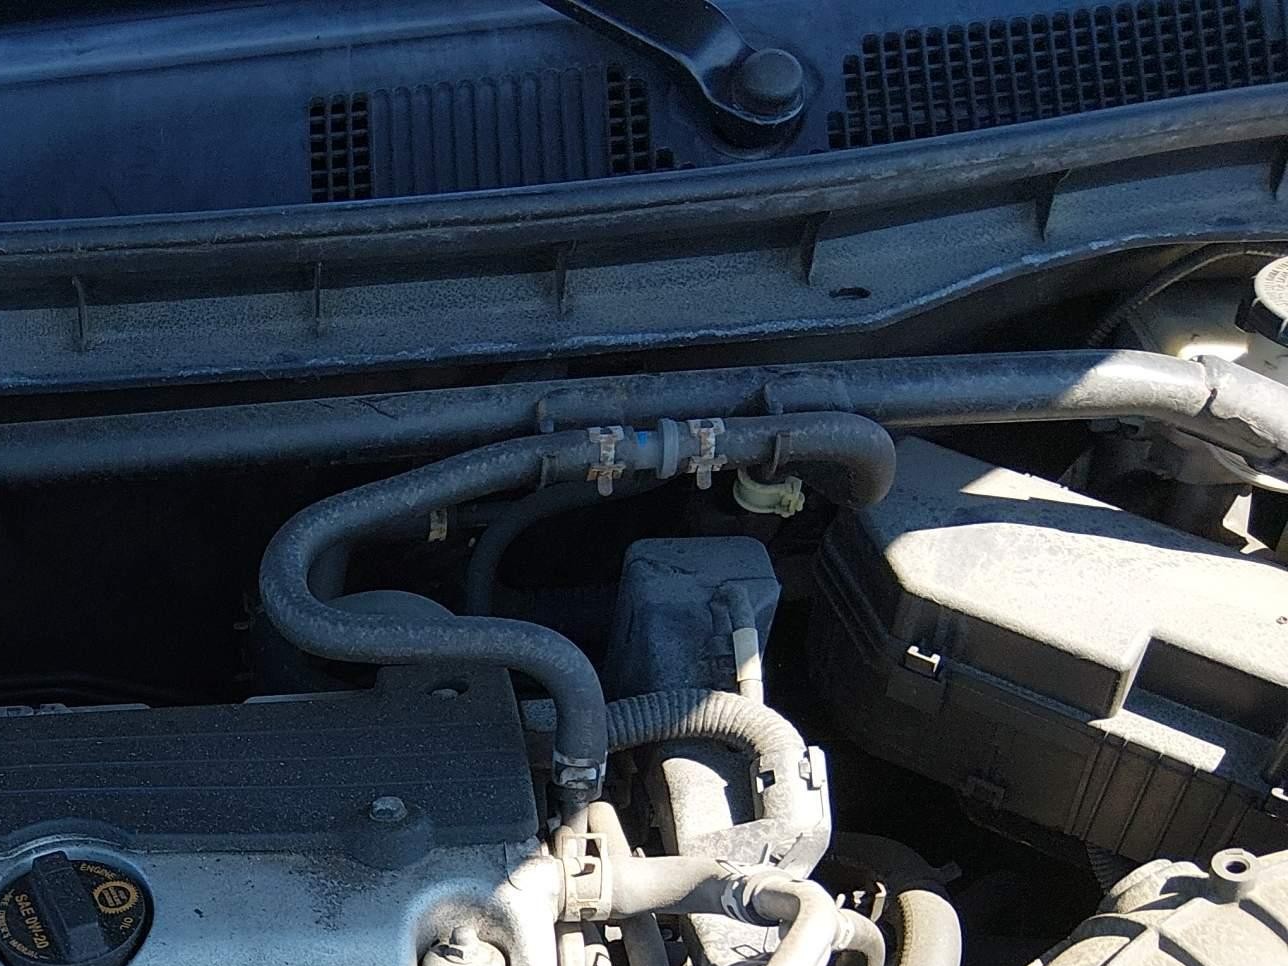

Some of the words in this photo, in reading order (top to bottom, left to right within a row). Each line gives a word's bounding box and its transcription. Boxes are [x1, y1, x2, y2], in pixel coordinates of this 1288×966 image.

[80, 863, 117, 881] ENGINE
[15, 894, 36, 917] SAE
[25, 916, 50, 949] 0W-20
[120, 917, 134, 930] OIL
